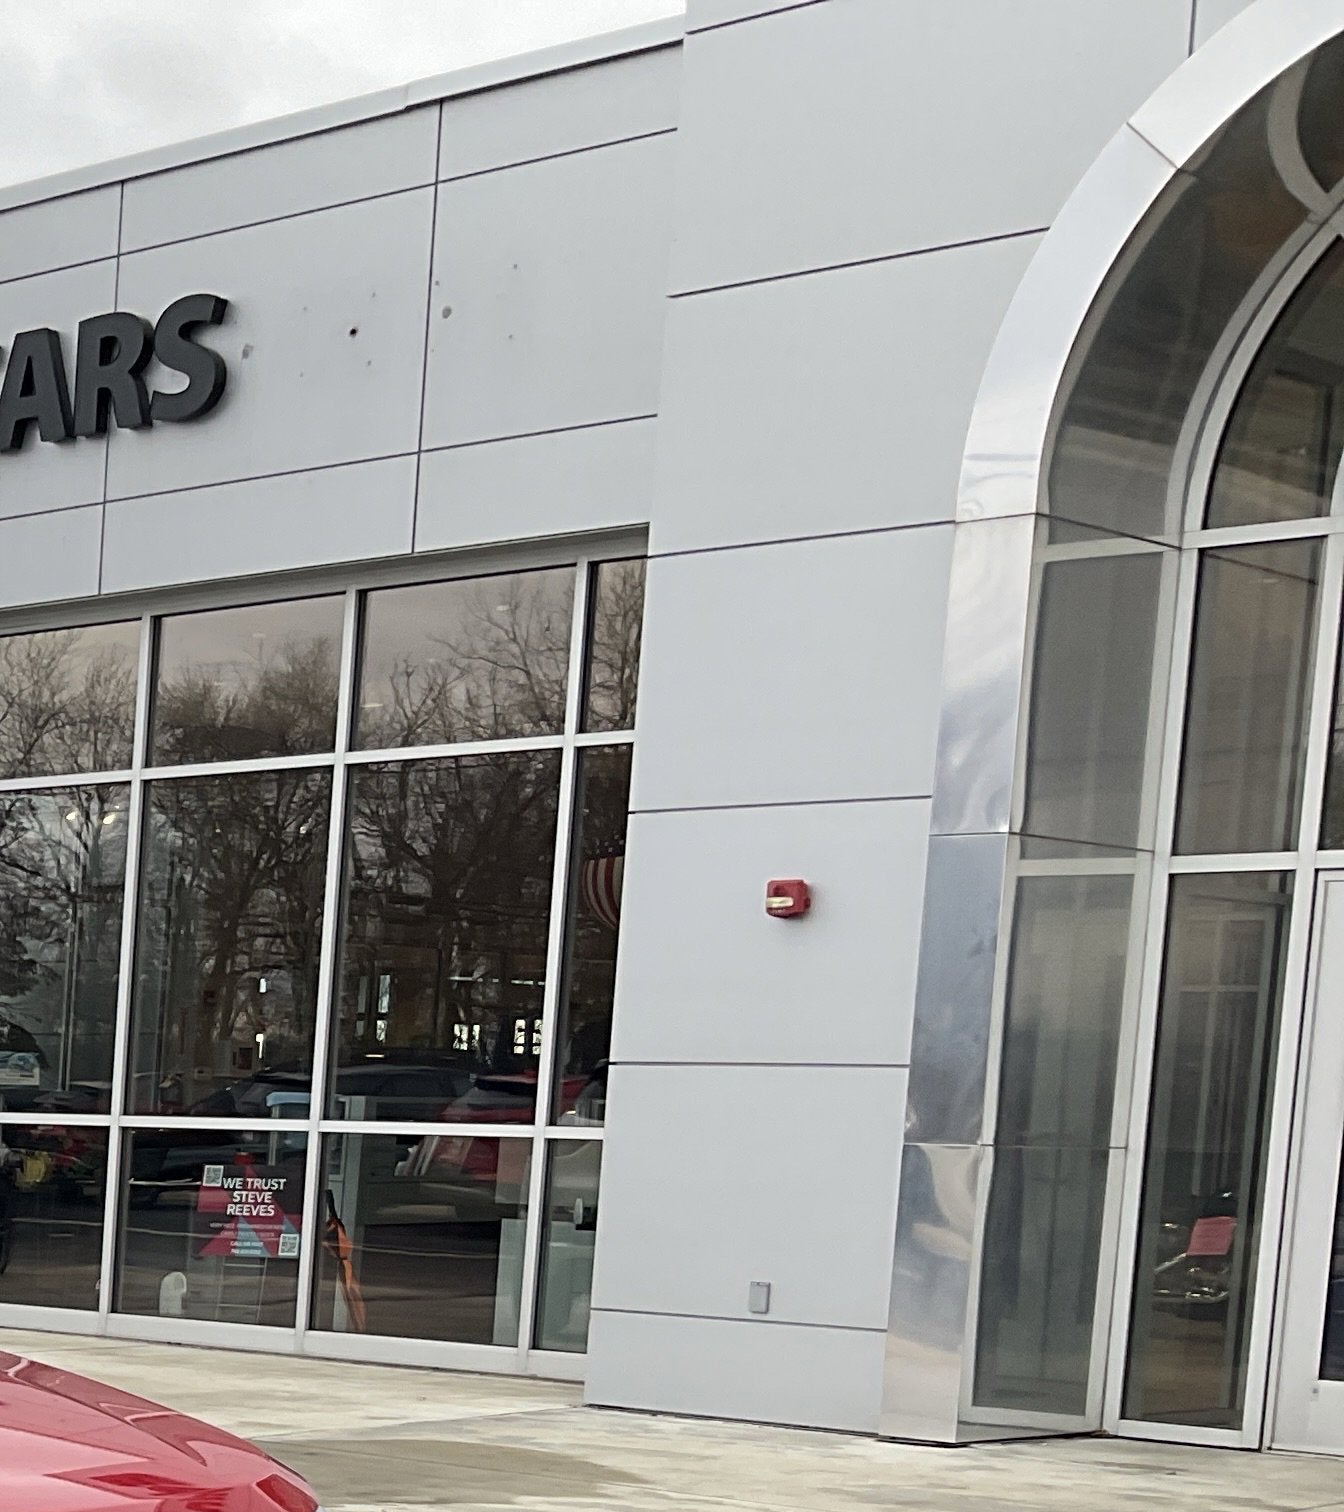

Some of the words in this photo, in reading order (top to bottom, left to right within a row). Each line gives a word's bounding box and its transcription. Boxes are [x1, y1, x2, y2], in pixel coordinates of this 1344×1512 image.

[223, 1178, 243, 1189] WE
[247, 1178, 286, 1190] TRUST
[232, 1191, 273, 1203] STEVE
[226, 1203, 275, 1217] REEVES
